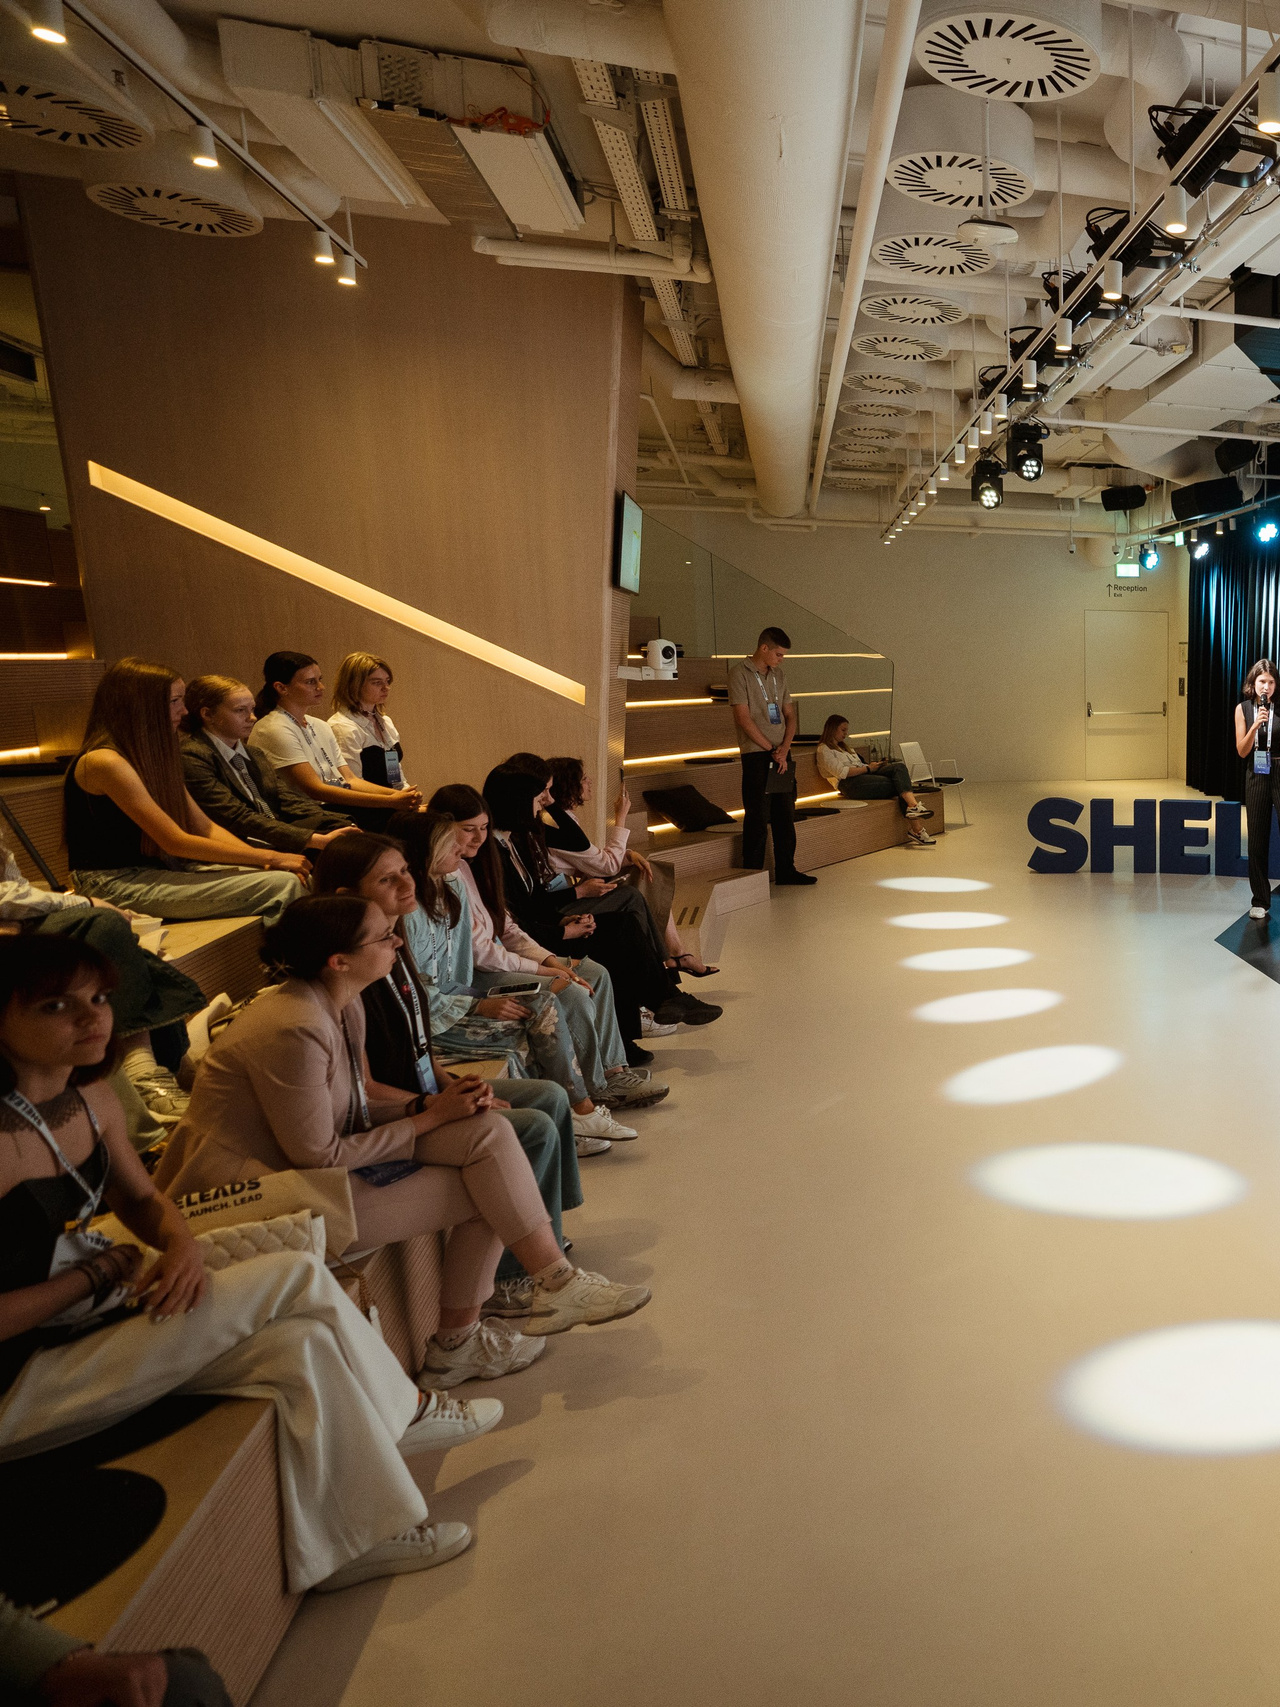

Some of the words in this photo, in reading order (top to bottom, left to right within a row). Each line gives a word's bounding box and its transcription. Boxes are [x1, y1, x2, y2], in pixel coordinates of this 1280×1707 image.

[1113, 584, 1148, 593] Reception
[173, 1177, 261, 1209] ELEADS
[185, 1203, 232, 1219] AUNCH.
[233, 1193, 263, 1207] LEAD
